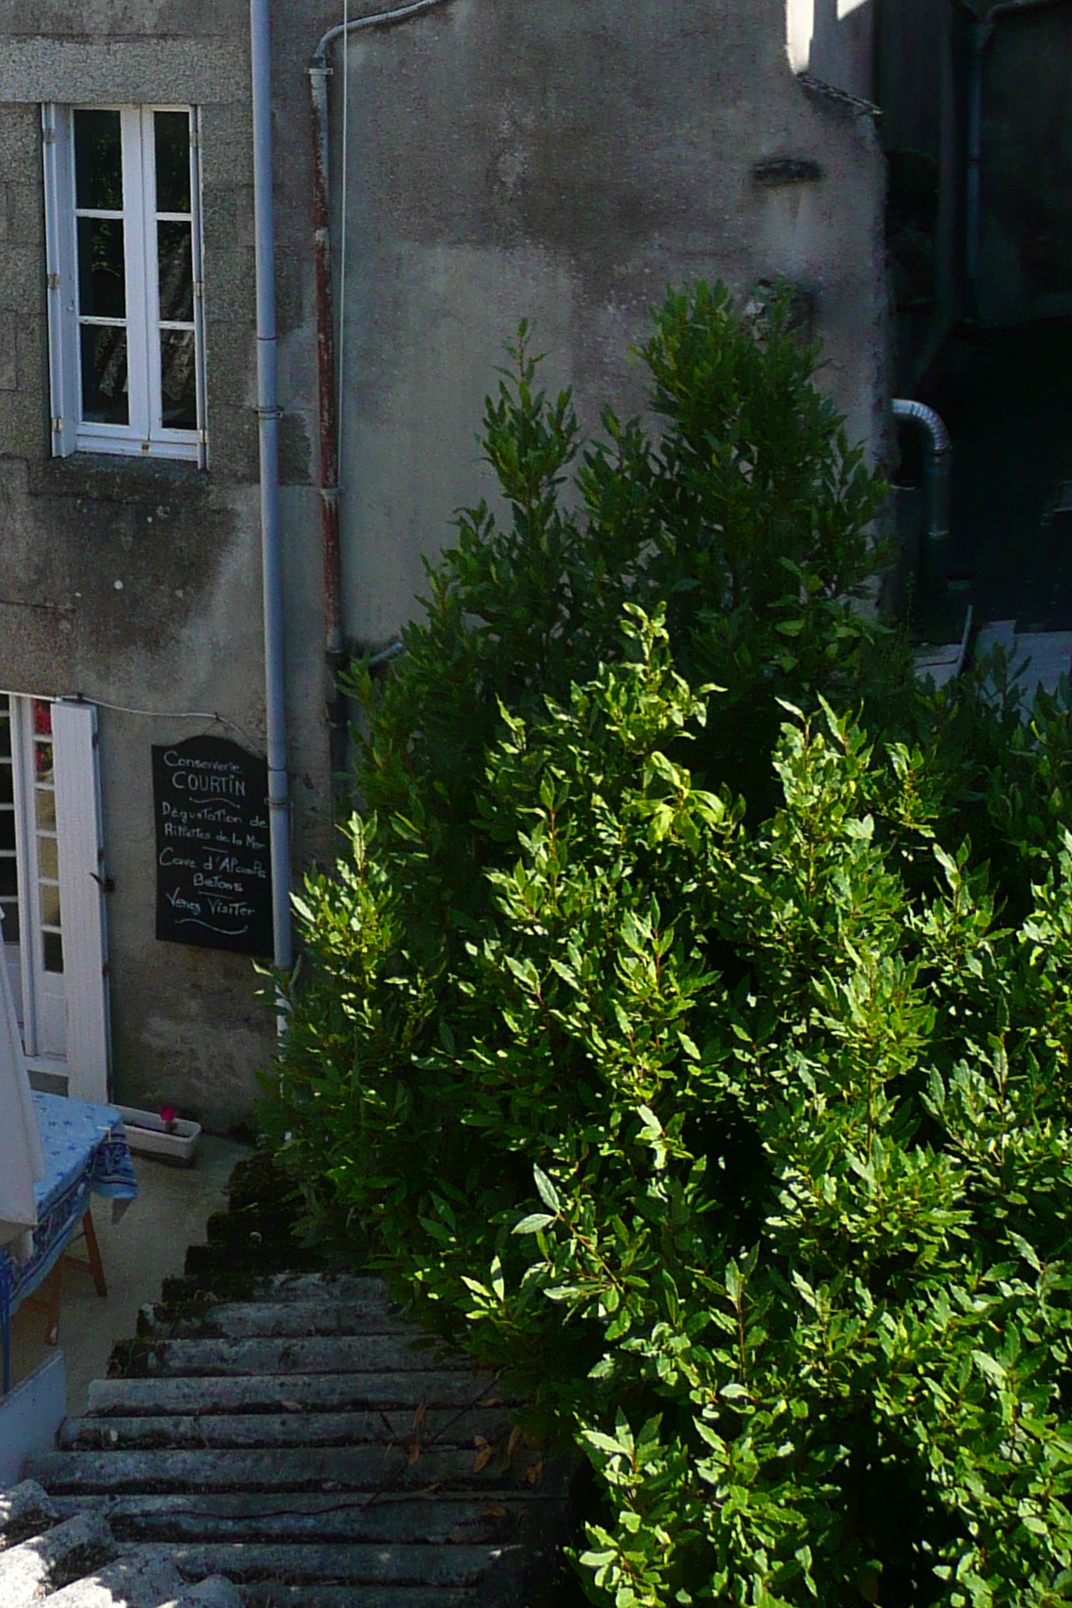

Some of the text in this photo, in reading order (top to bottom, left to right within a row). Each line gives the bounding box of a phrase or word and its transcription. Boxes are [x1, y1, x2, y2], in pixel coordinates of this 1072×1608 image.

[164, 751, 242, 773] Conserverie
[172, 771, 245, 796] COURTIN
[249, 815, 269, 829] de
[216, 830, 230, 843] de
[232, 833, 243, 846] la
[159, 847, 197, 868] Cave
[207, 897, 256, 916] Visiter
